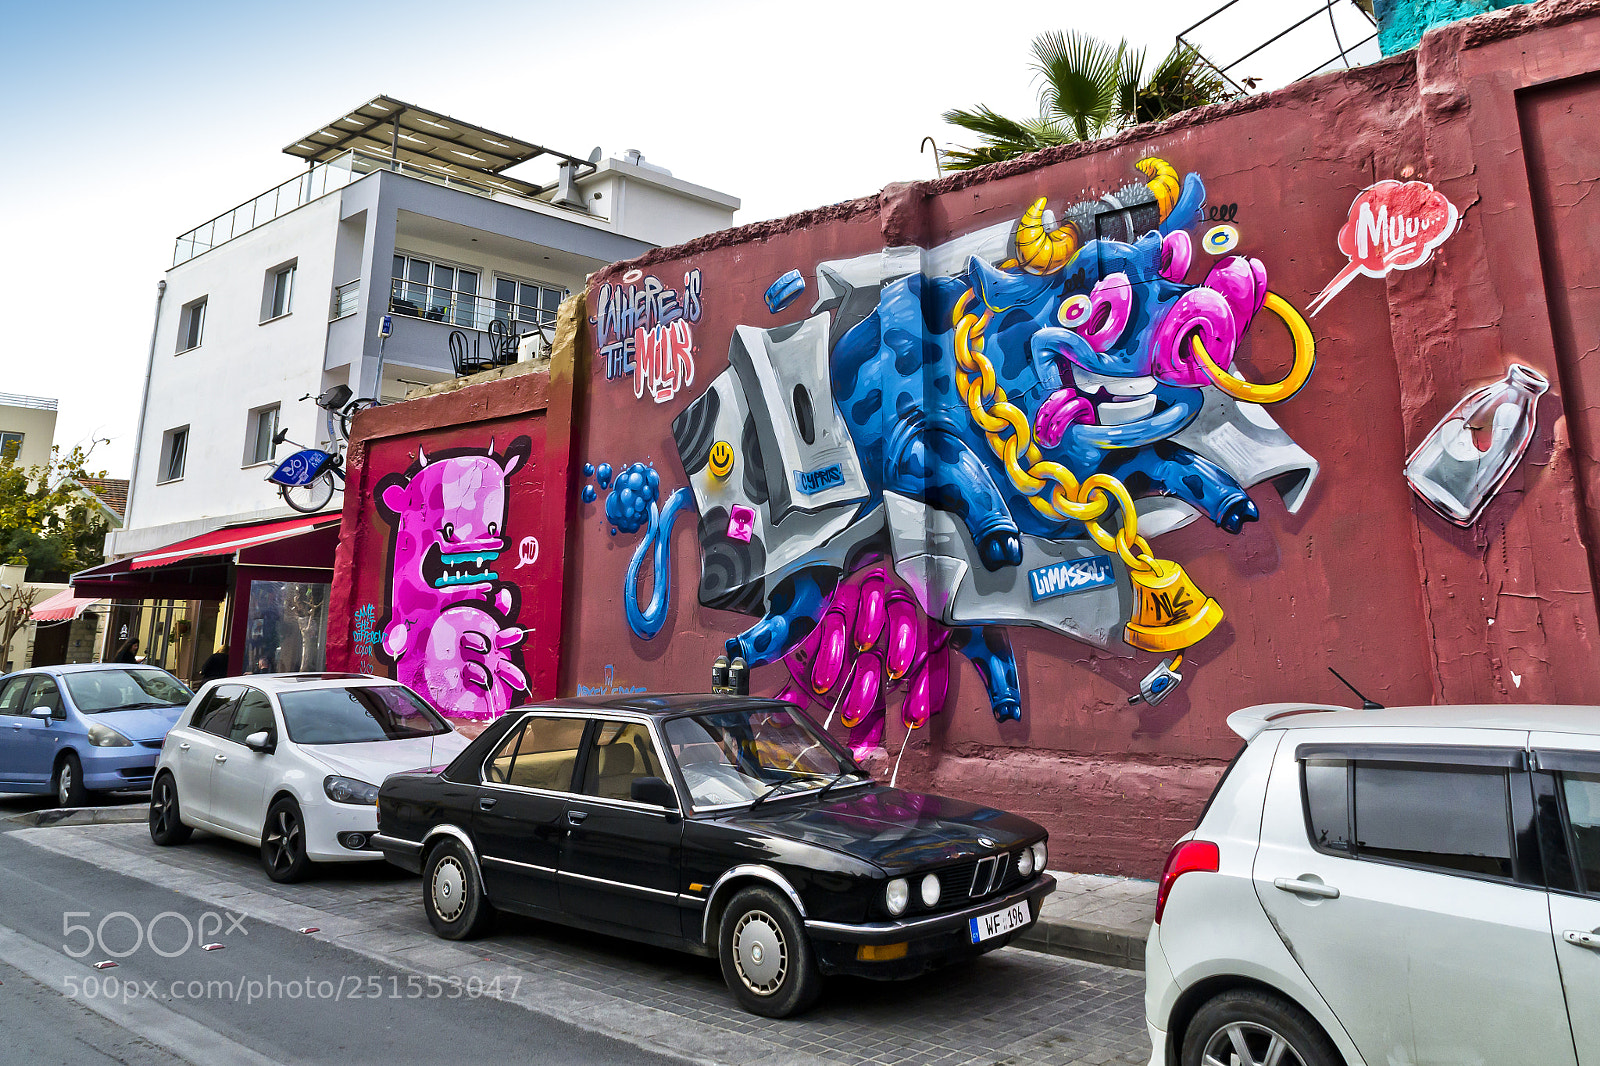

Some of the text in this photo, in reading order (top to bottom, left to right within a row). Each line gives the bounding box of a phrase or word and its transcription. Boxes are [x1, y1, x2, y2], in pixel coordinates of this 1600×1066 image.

[589, 275, 684, 349] WHERE
[600, 337, 636, 380] THE
[985, 913, 1000, 936] WF
[1007, 905, 1024, 928] 196
